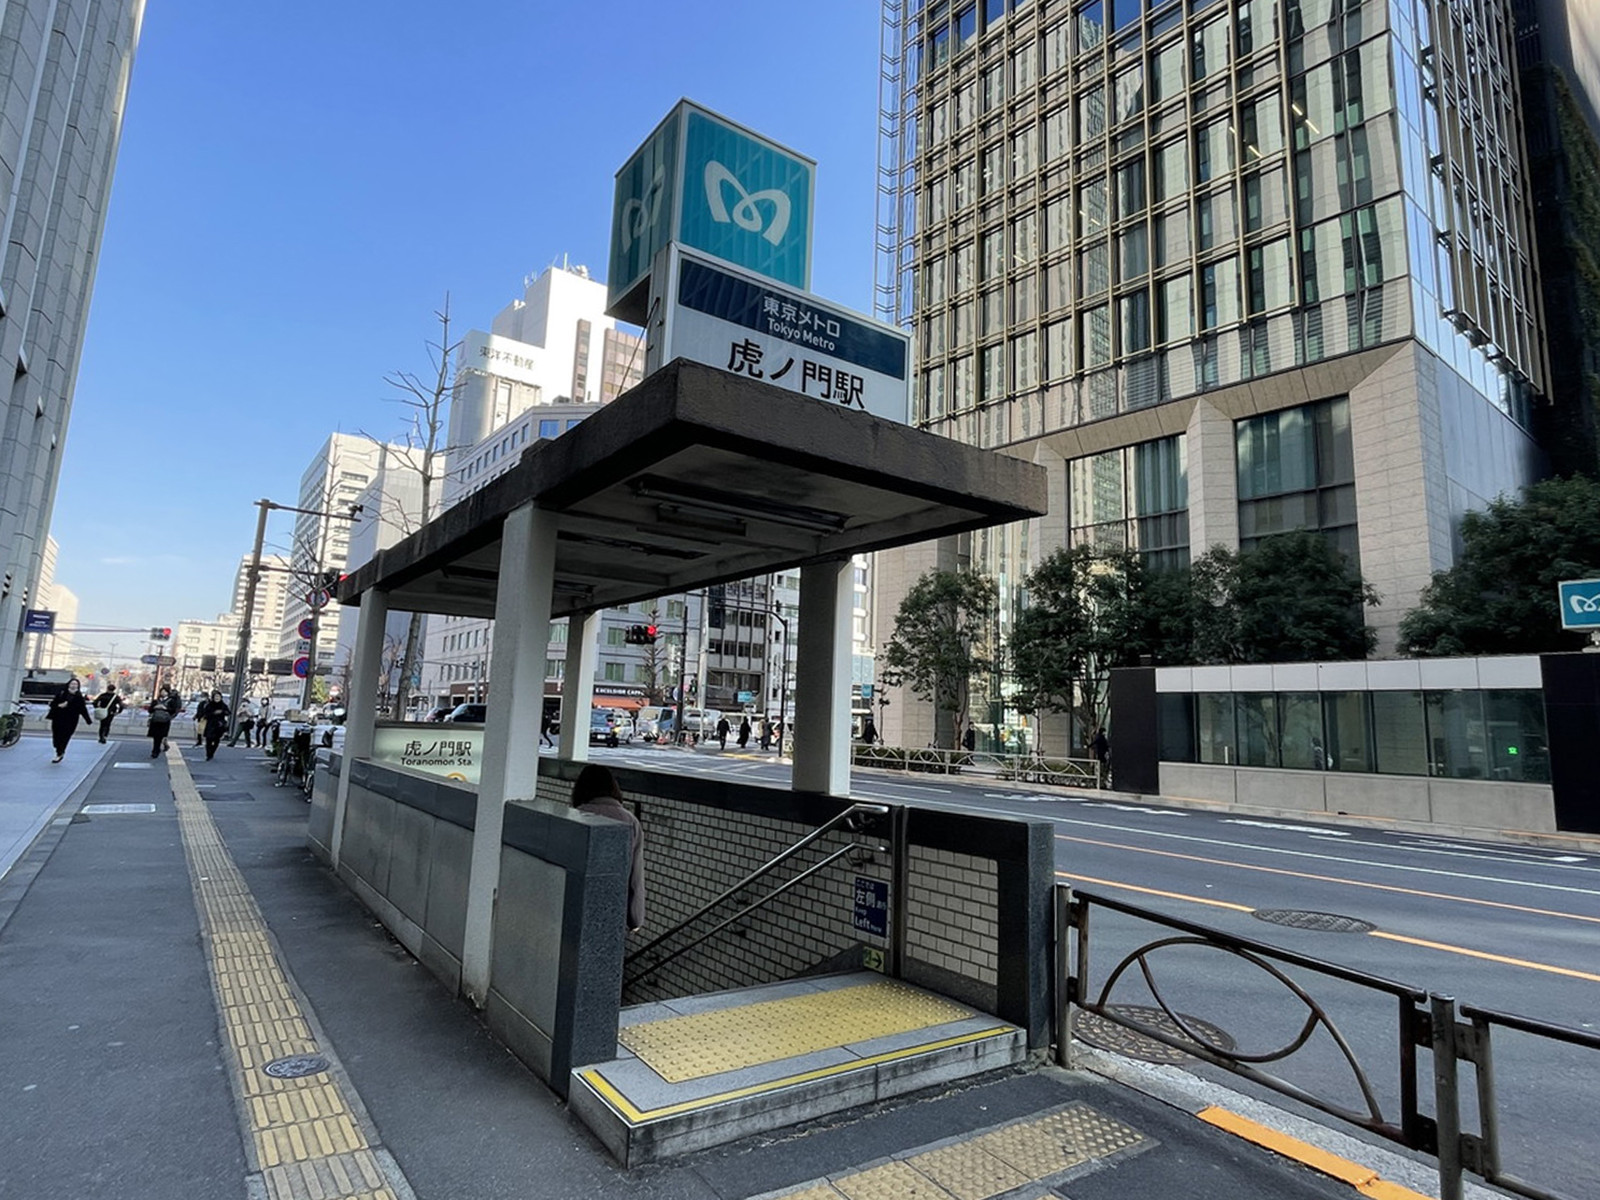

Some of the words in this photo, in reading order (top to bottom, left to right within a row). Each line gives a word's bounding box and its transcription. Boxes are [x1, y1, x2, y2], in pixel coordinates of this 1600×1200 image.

[763, 296, 840, 338] 東京メトロ
[767, 317, 800, 340] Tokyo
[803, 329, 836, 351] Metro
[727, 338, 865, 409] 虎ノ門駅
[595, 687, 626, 695] EXCELSIOR
[404, 740, 472, 757] 虎ノ門駅
[401, 757, 455, 766] Toranomon
[457, 757, 475, 766] Sta.
[855, 916, 870, 930] Left
